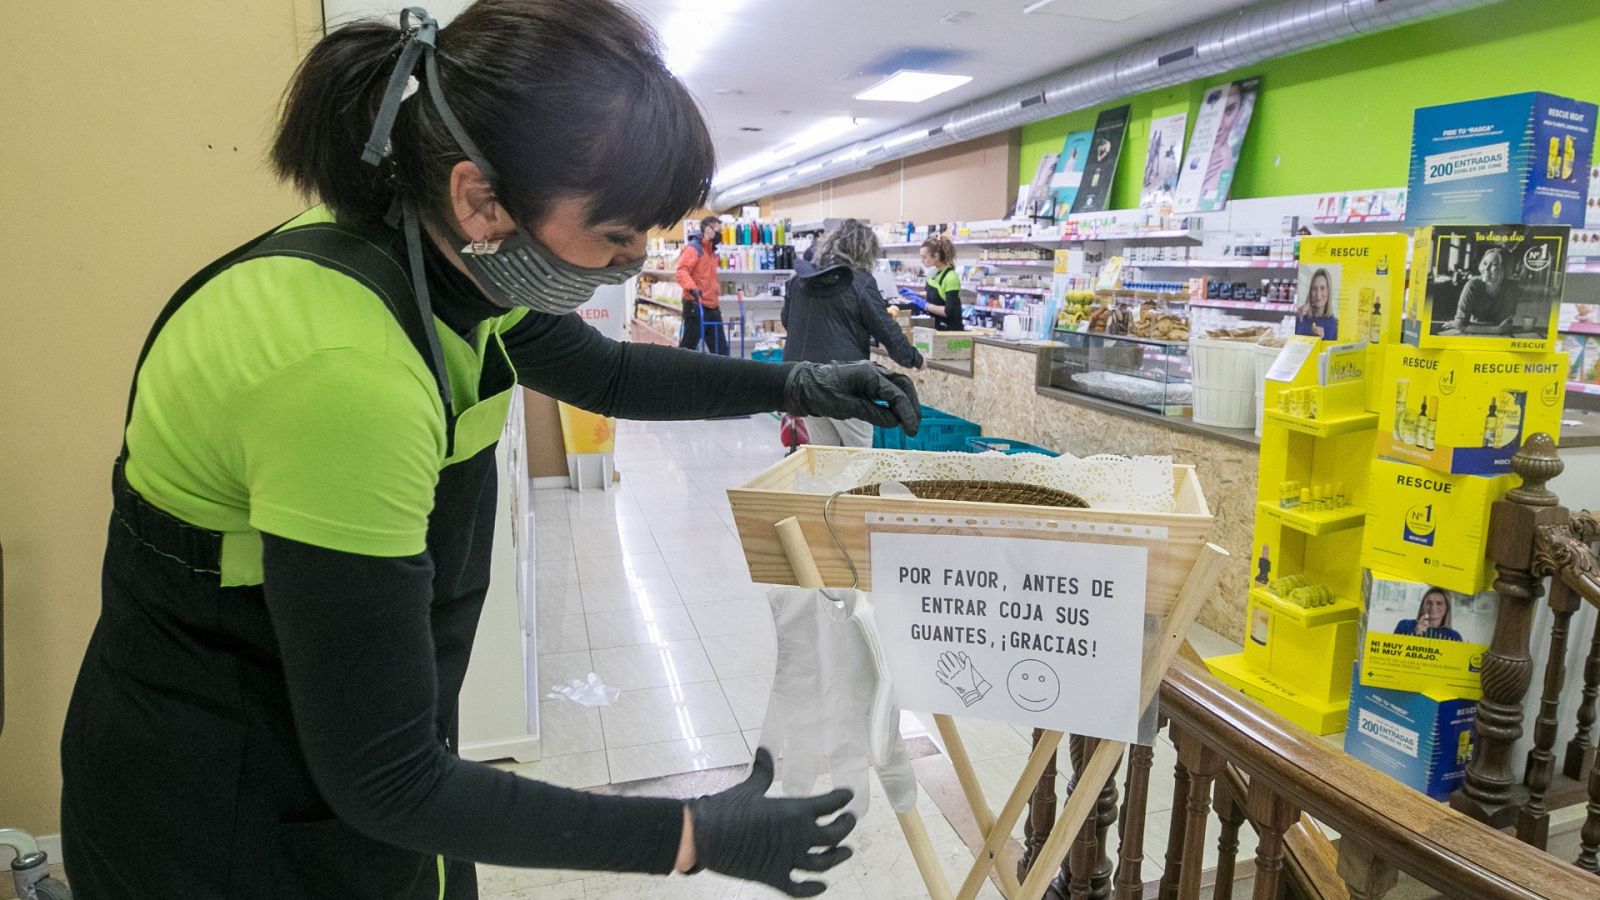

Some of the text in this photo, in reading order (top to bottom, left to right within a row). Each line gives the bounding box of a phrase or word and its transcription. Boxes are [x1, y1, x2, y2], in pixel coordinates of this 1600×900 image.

[1454, 153, 1503, 168] ENTRADAS
[1430, 162, 1453, 178] 200
[1330, 247, 1370, 257] RESCUE
[578, 308, 609, 319] LEDA
[1510, 341, 1547, 350] RESCUE
[1403, 356, 1439, 371] RESCUE
[1473, 363, 1559, 374] RESCUE NIGHT
[1396, 474, 1453, 494] RESCUE
[899, 566, 1115, 599] POR FAVOR, ANTES DE
[921, 596, 1090, 626] ENTRAR COJA SUS
[1382, 648, 1403, 656] MUY
[1383, 642, 1404, 650] MUY
[1405, 645, 1443, 656] ARRIBA,
[1361, 718, 1379, 735] 200
[1379, 725, 1415, 746] ENTRADAS
